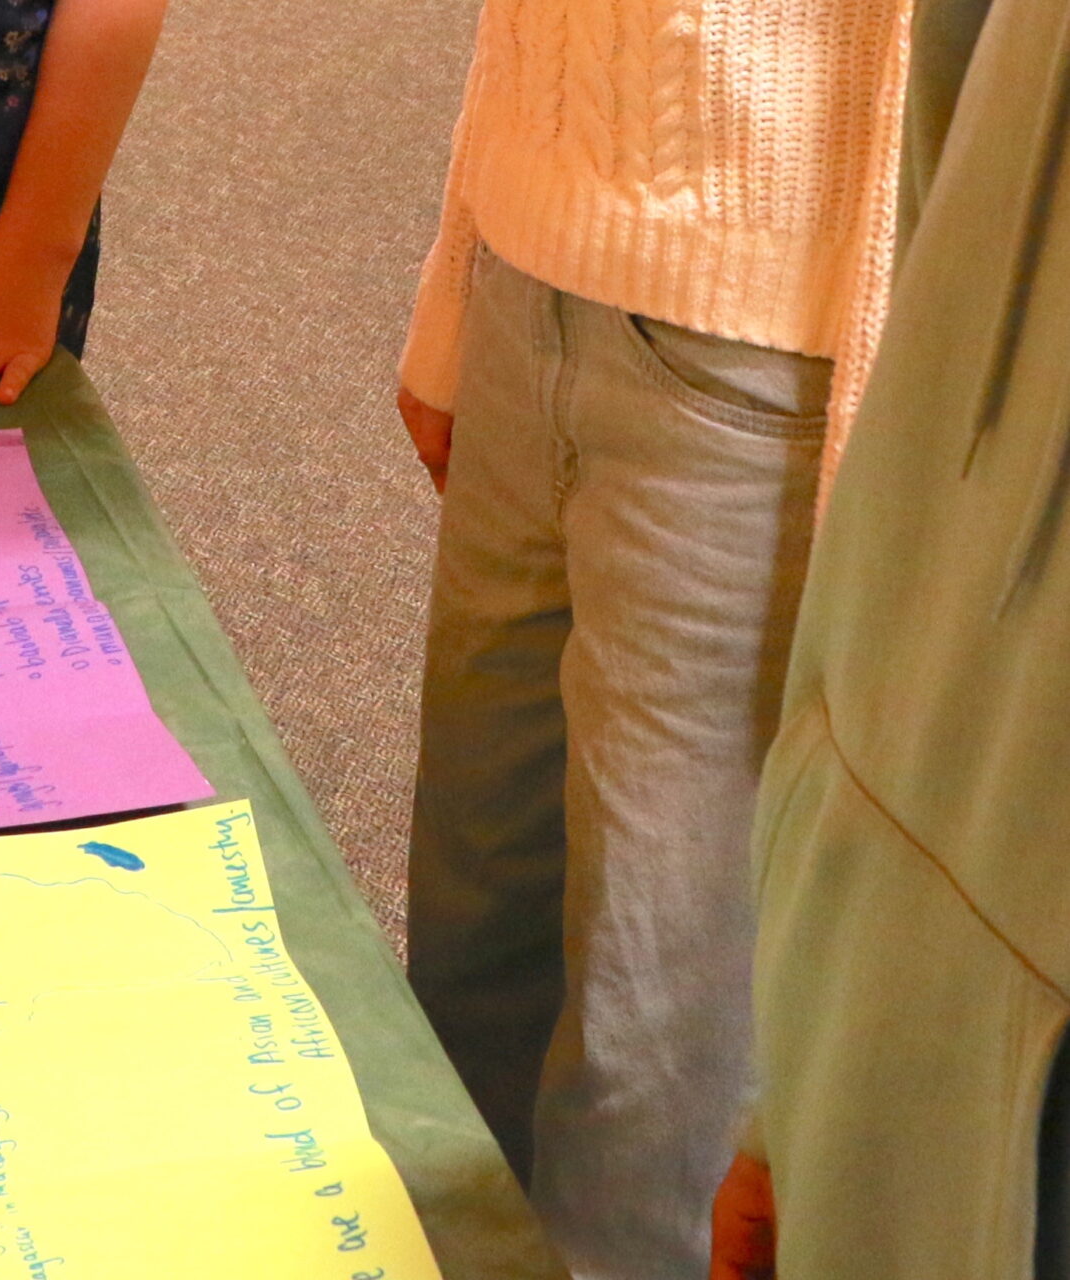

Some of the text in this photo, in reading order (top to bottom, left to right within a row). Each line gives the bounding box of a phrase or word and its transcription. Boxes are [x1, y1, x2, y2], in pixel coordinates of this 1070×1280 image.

[222, 973, 263, 1003] and
[247, 1014, 286, 1064] Asian
[279, 992, 334, 1060] African
[247, 1082, 303, 1111] of
[313, 1181, 344, 1199] a
[327, 1210, 368, 1253] are
